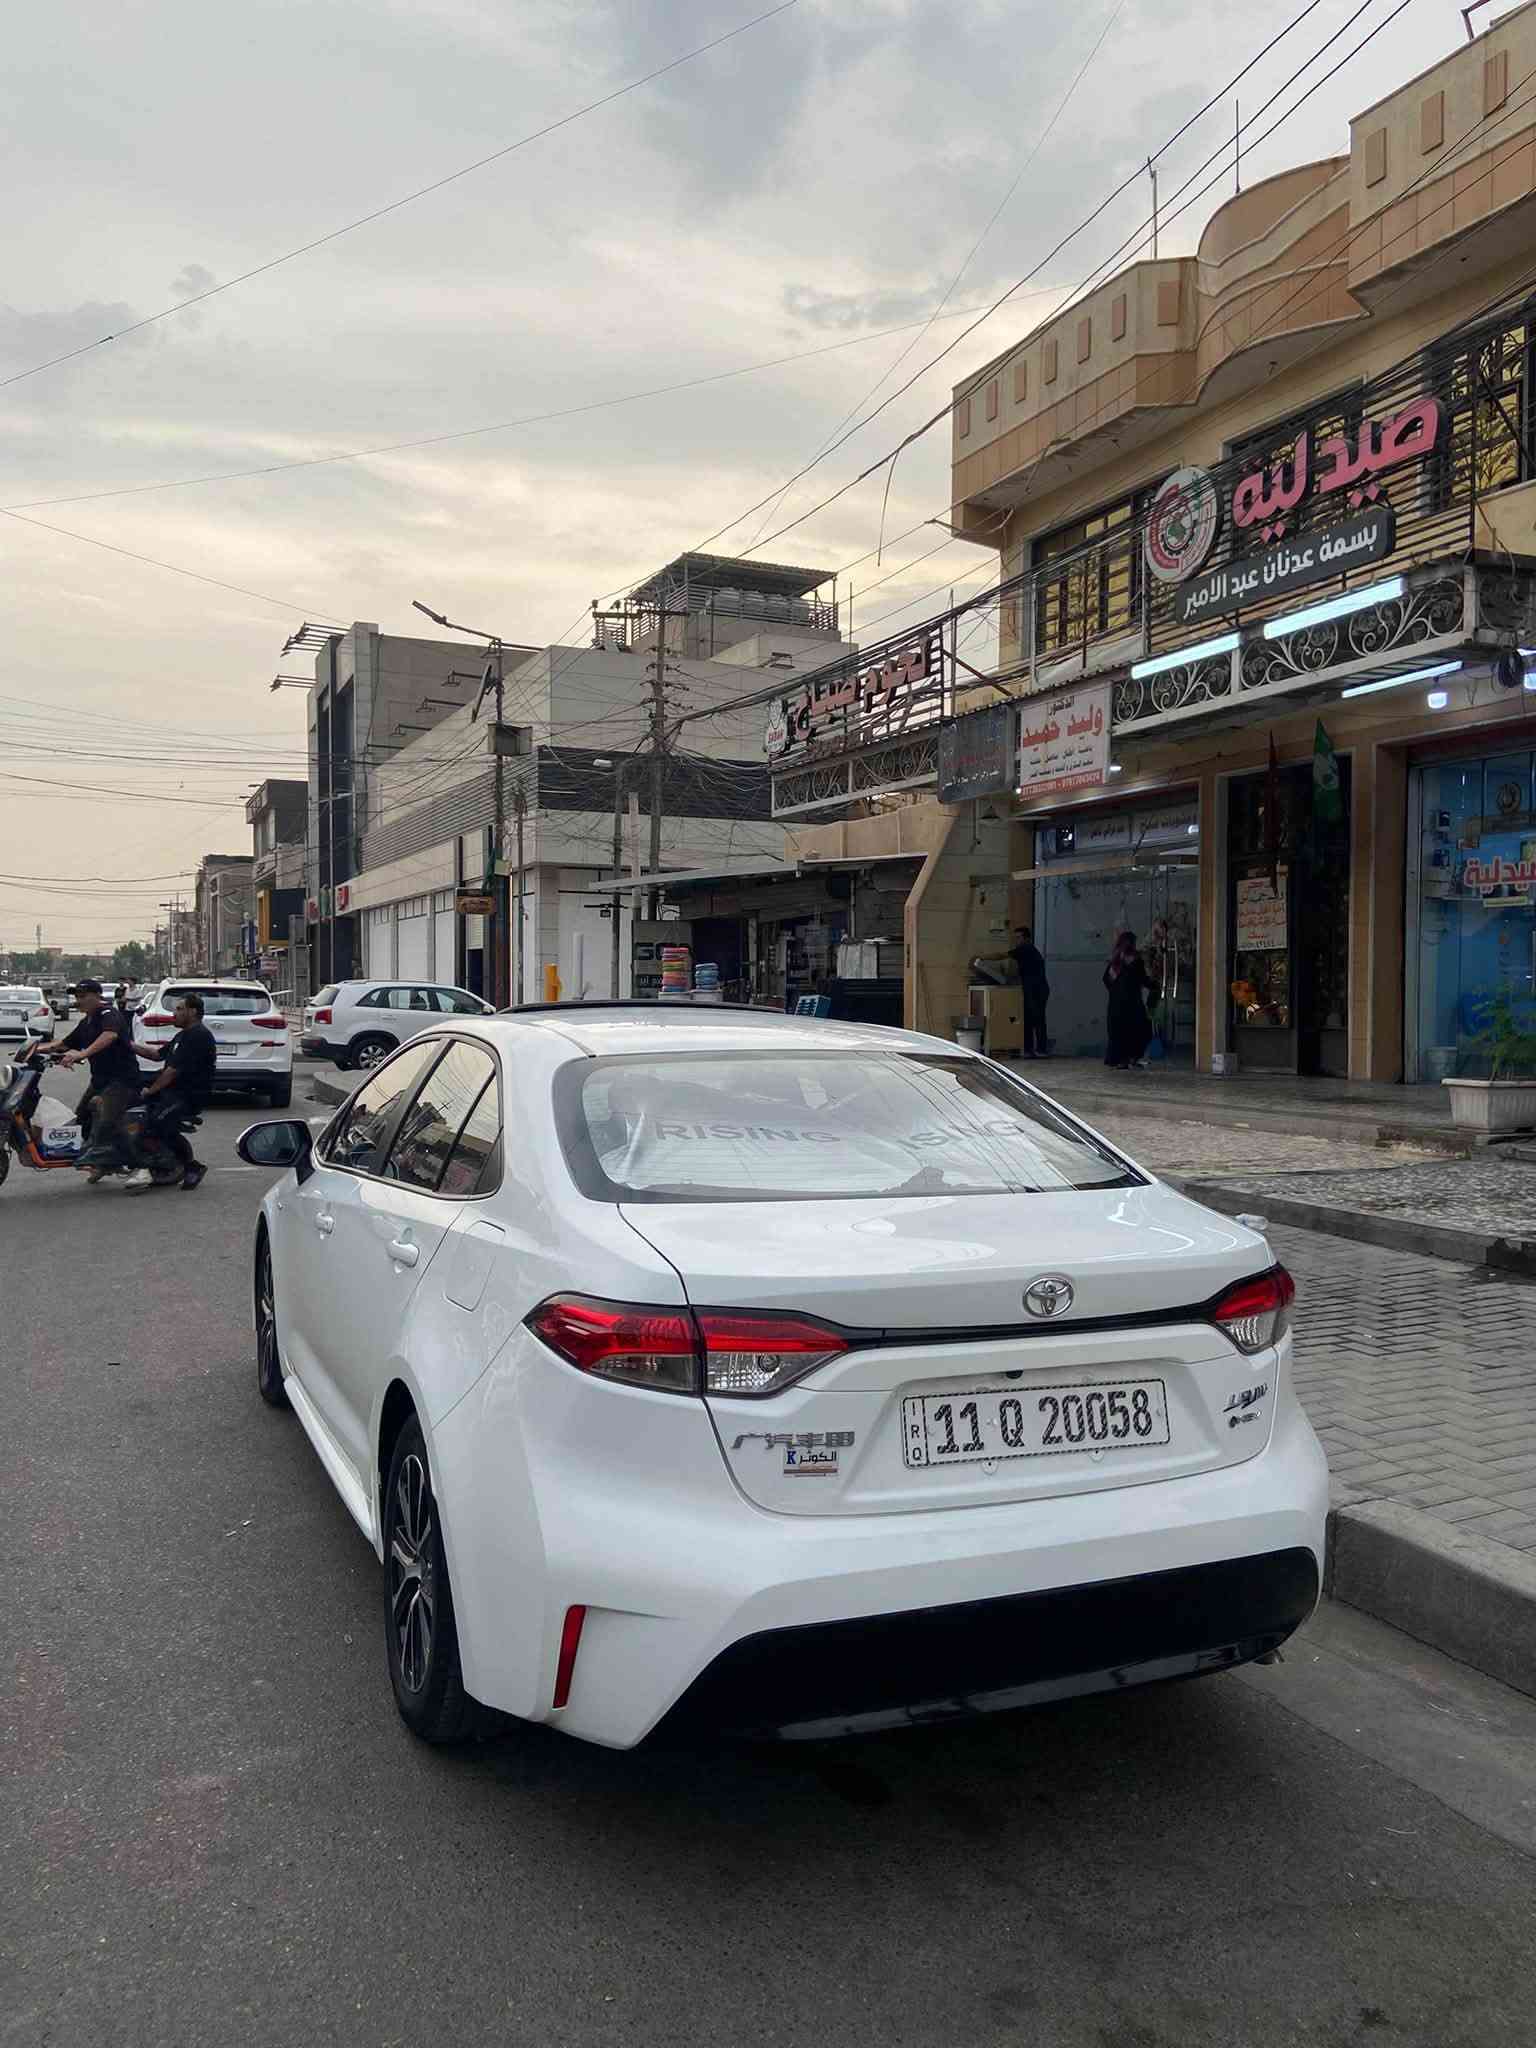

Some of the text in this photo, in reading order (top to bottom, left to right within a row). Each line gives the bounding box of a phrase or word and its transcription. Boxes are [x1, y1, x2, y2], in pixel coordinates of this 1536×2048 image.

[1319, 523, 1378, 563] بسمة
[1263, 549, 1315, 584] عدنان
[1231, 568, 1260, 599] عبد
[1022, 704, 1103, 752] وليد حميد
[655, 1120, 841, 1144] RISING
[934, 1388, 1151, 1454] 11 Q 20058
[785, 1450, 797, 1465] K
[799, 1450, 838, 1465] الكوثر
